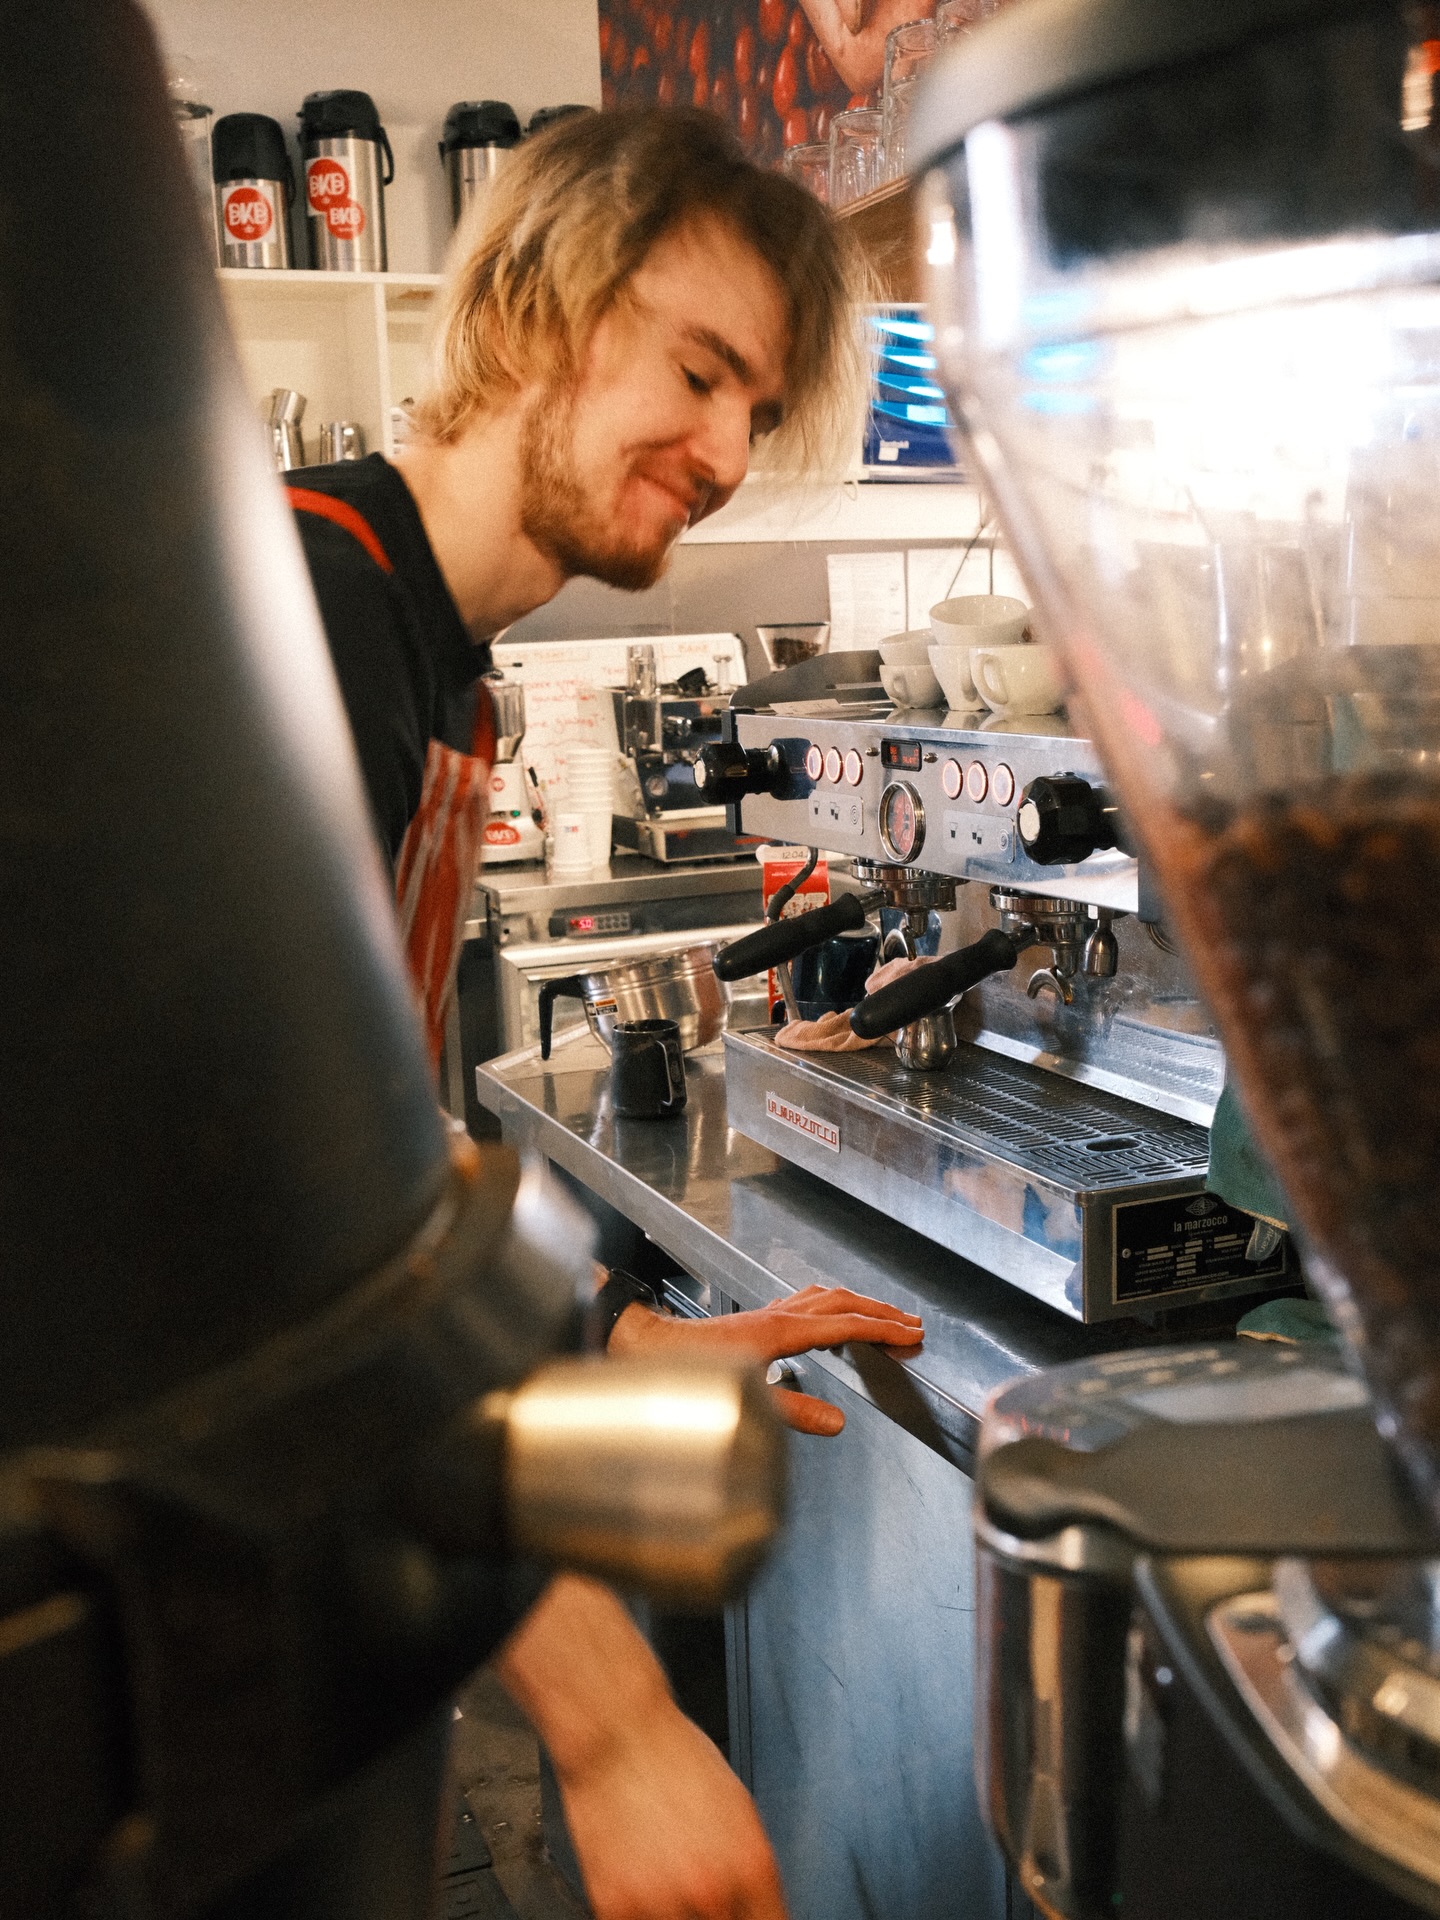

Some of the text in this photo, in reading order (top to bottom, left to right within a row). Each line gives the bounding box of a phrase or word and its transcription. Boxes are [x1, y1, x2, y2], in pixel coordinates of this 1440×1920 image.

[780, 1104, 837, 1146] MARZOCCO
[1173, 1221, 1182, 1233] la
[1185, 1215, 1228, 1230] marzocco
